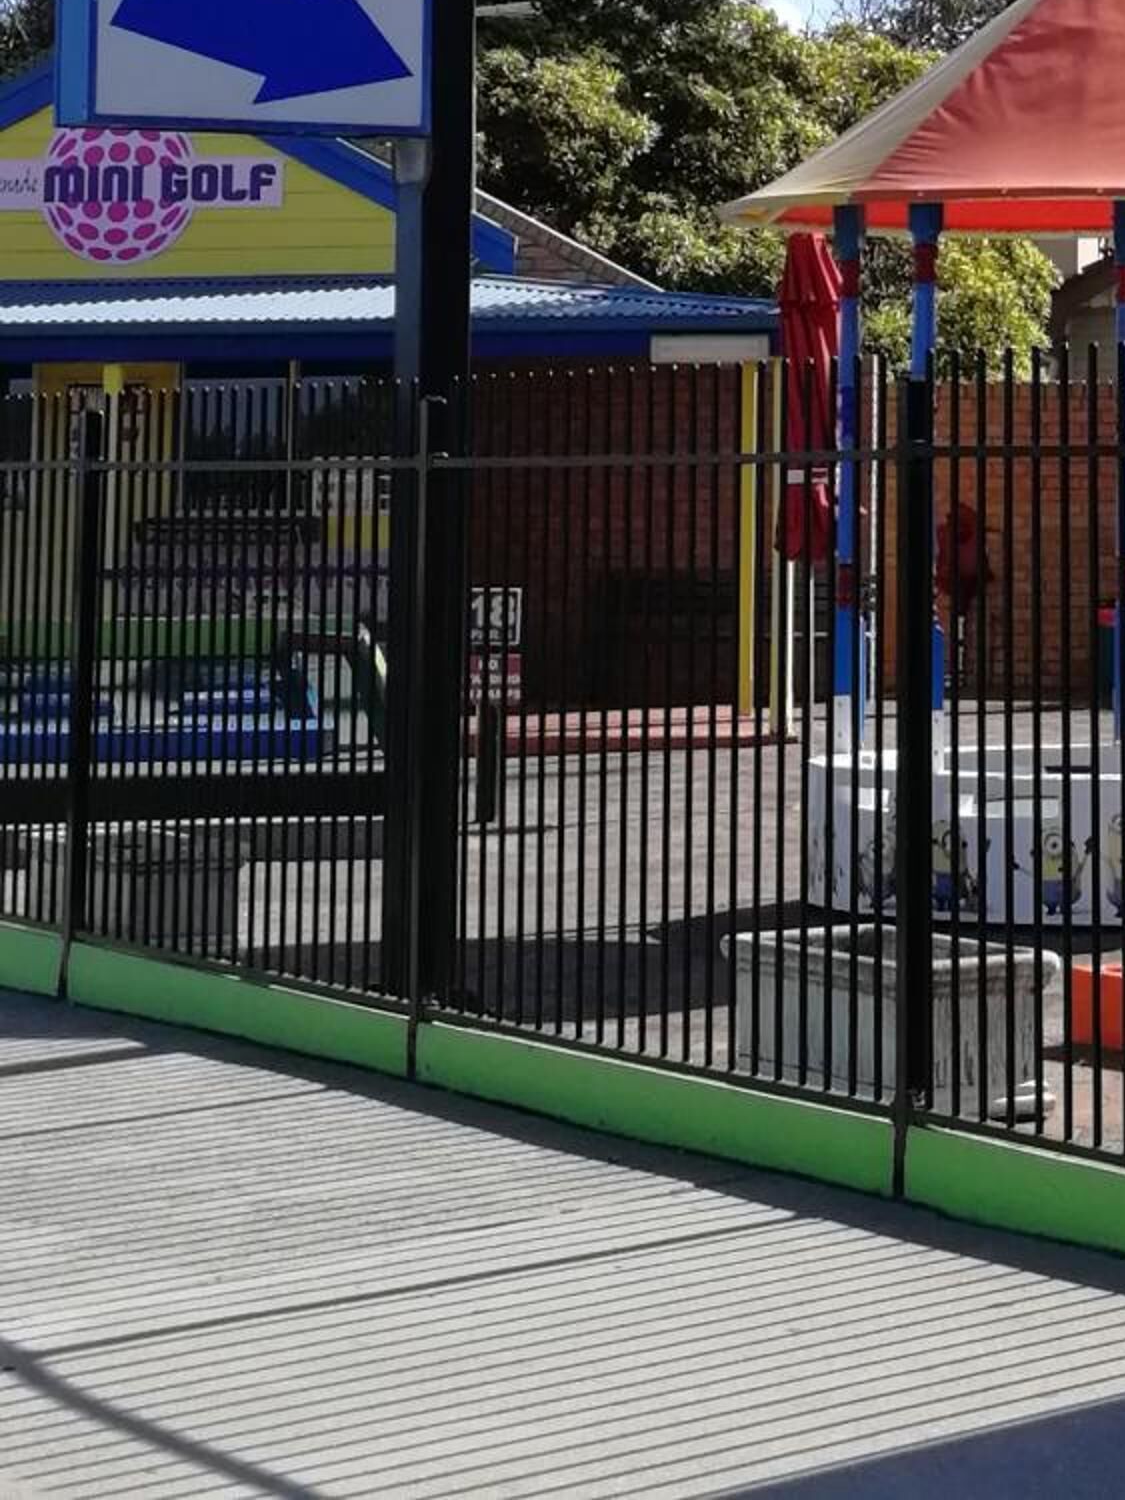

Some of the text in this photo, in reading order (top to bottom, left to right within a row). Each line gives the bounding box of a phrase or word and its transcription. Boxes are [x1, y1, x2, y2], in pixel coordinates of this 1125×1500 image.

[44, 165, 143, 202] MINI
[161, 164, 277, 201] GOLF
[471, 595, 515, 628] 18
